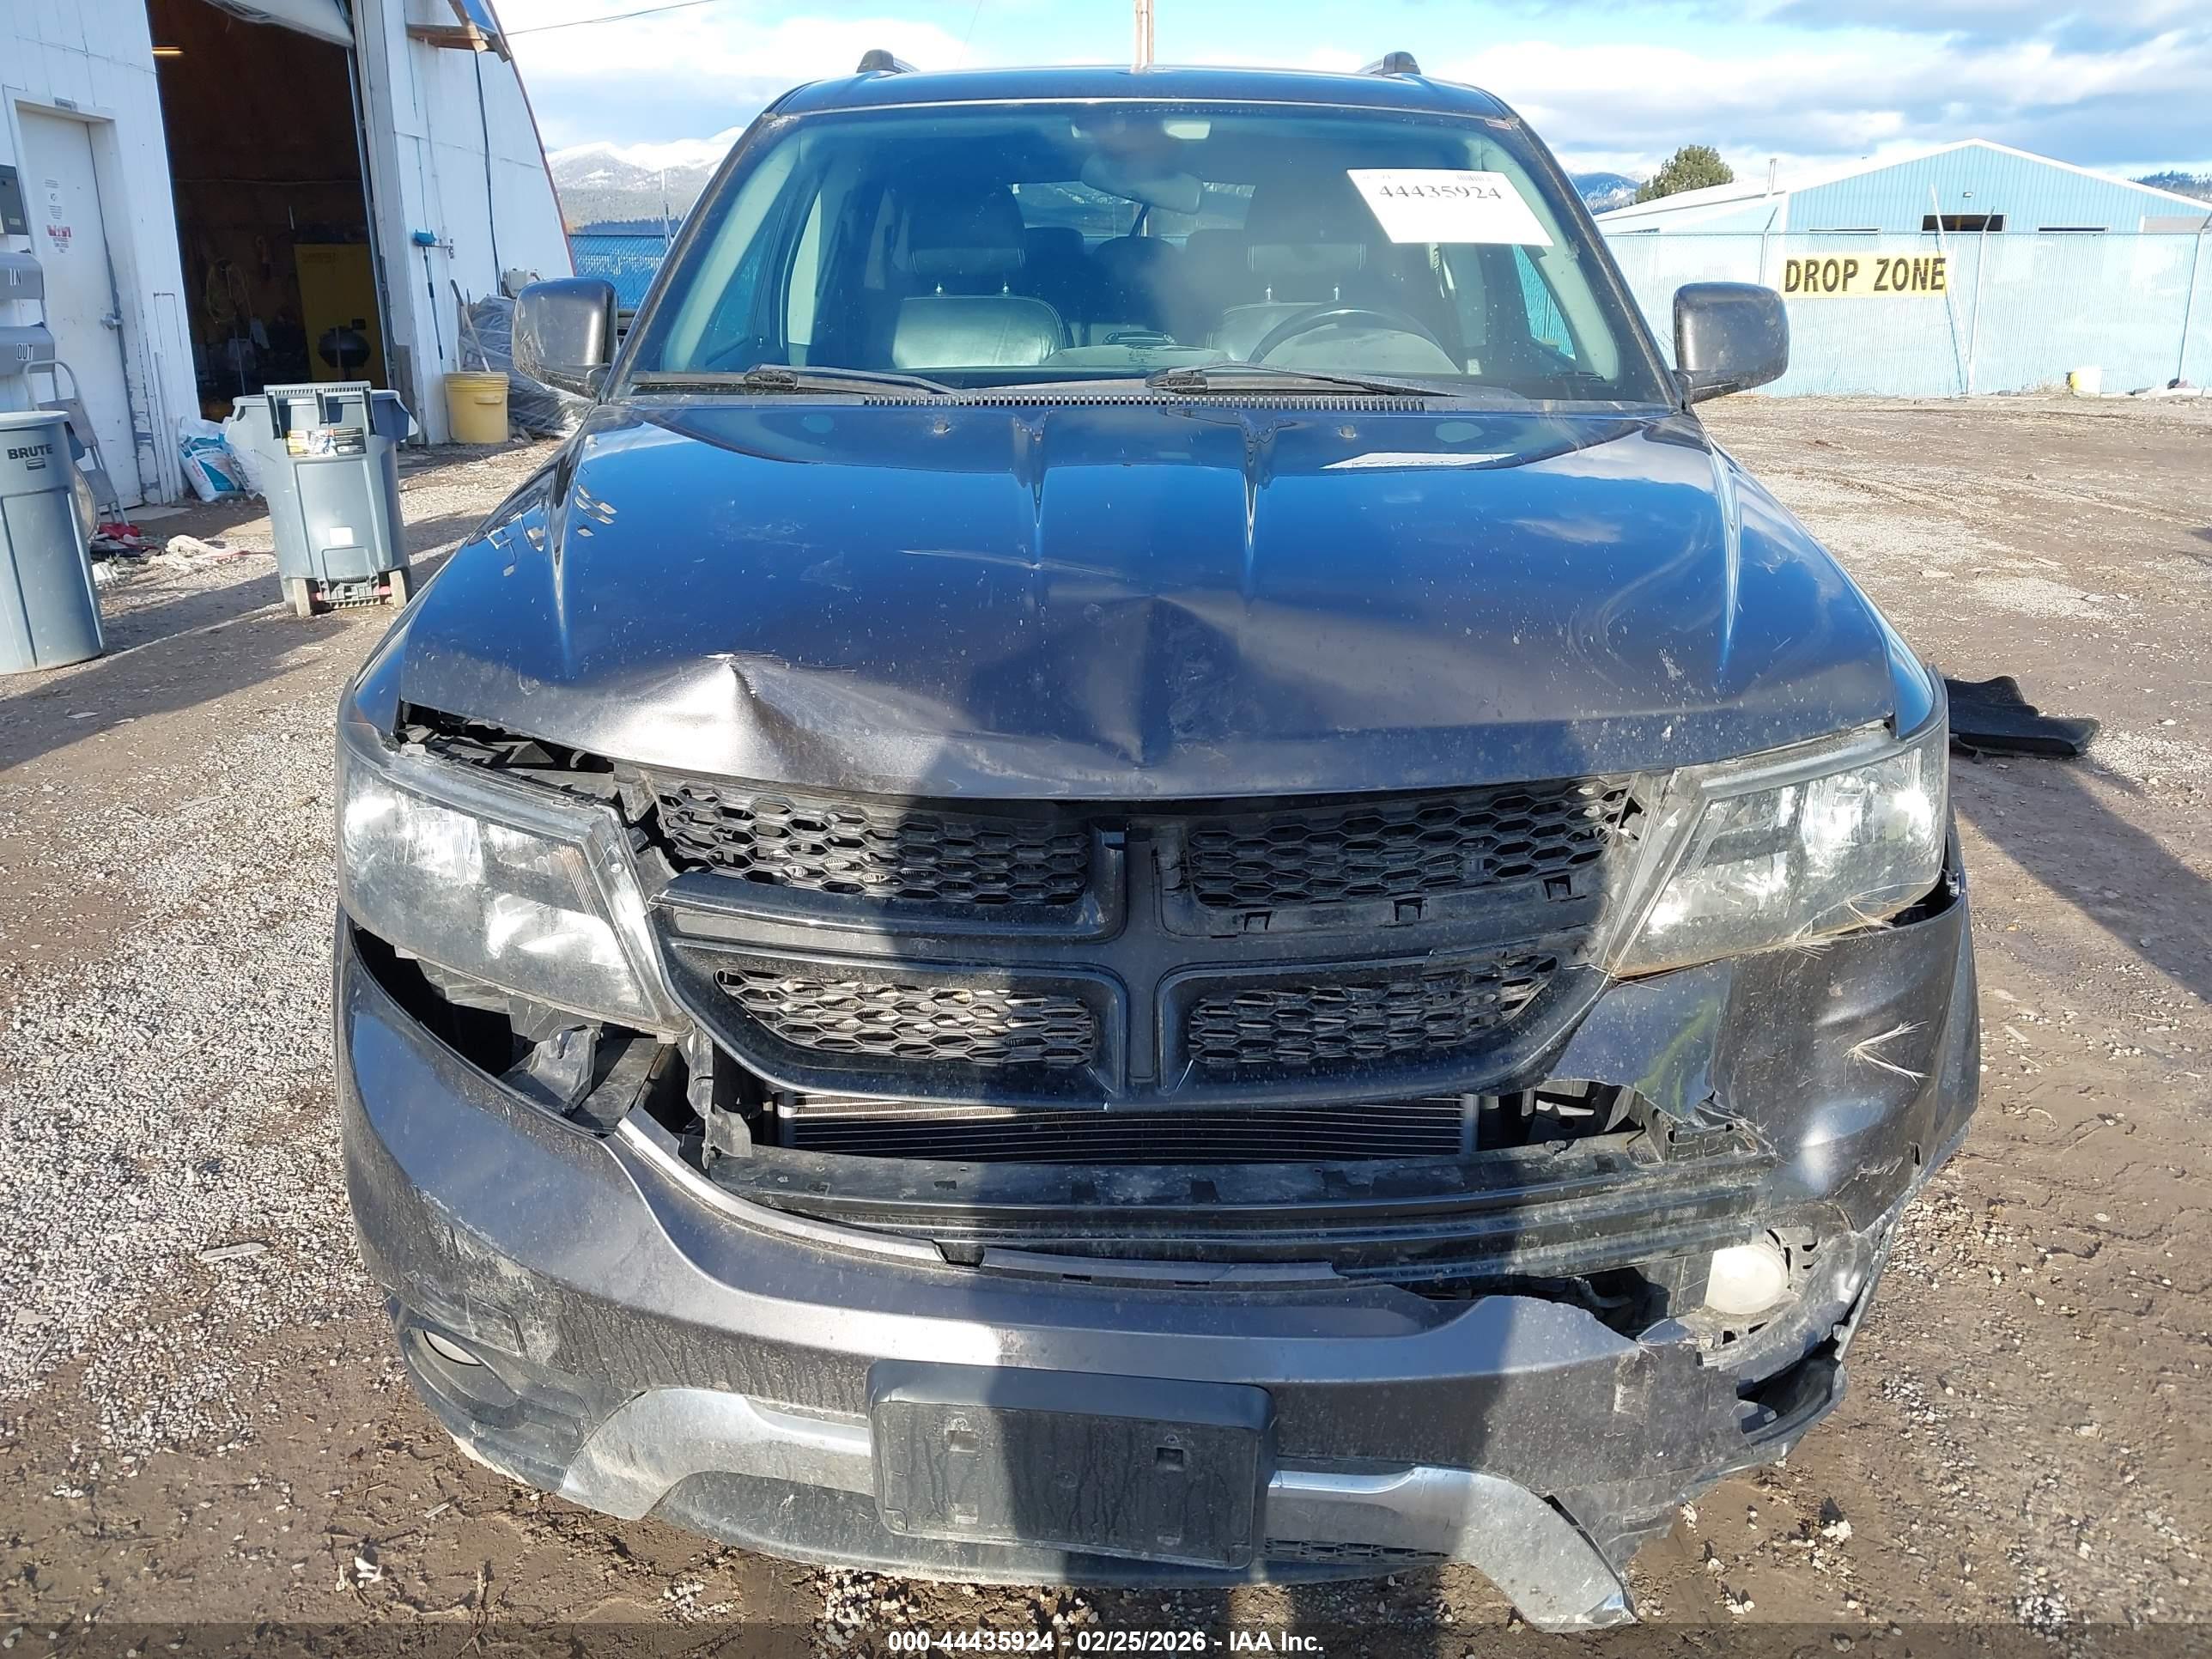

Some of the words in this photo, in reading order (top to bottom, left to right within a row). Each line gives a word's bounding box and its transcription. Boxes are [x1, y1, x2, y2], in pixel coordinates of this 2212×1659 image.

[1380, 185, 1502, 199] 44435924
[9, 268, 21, 286] IN
[1785, 258, 1858, 292] DROP
[1874, 258, 1946, 291] ZONE
[16, 343, 33, 361] OUT
[7, 444, 53, 459] BRUTE
